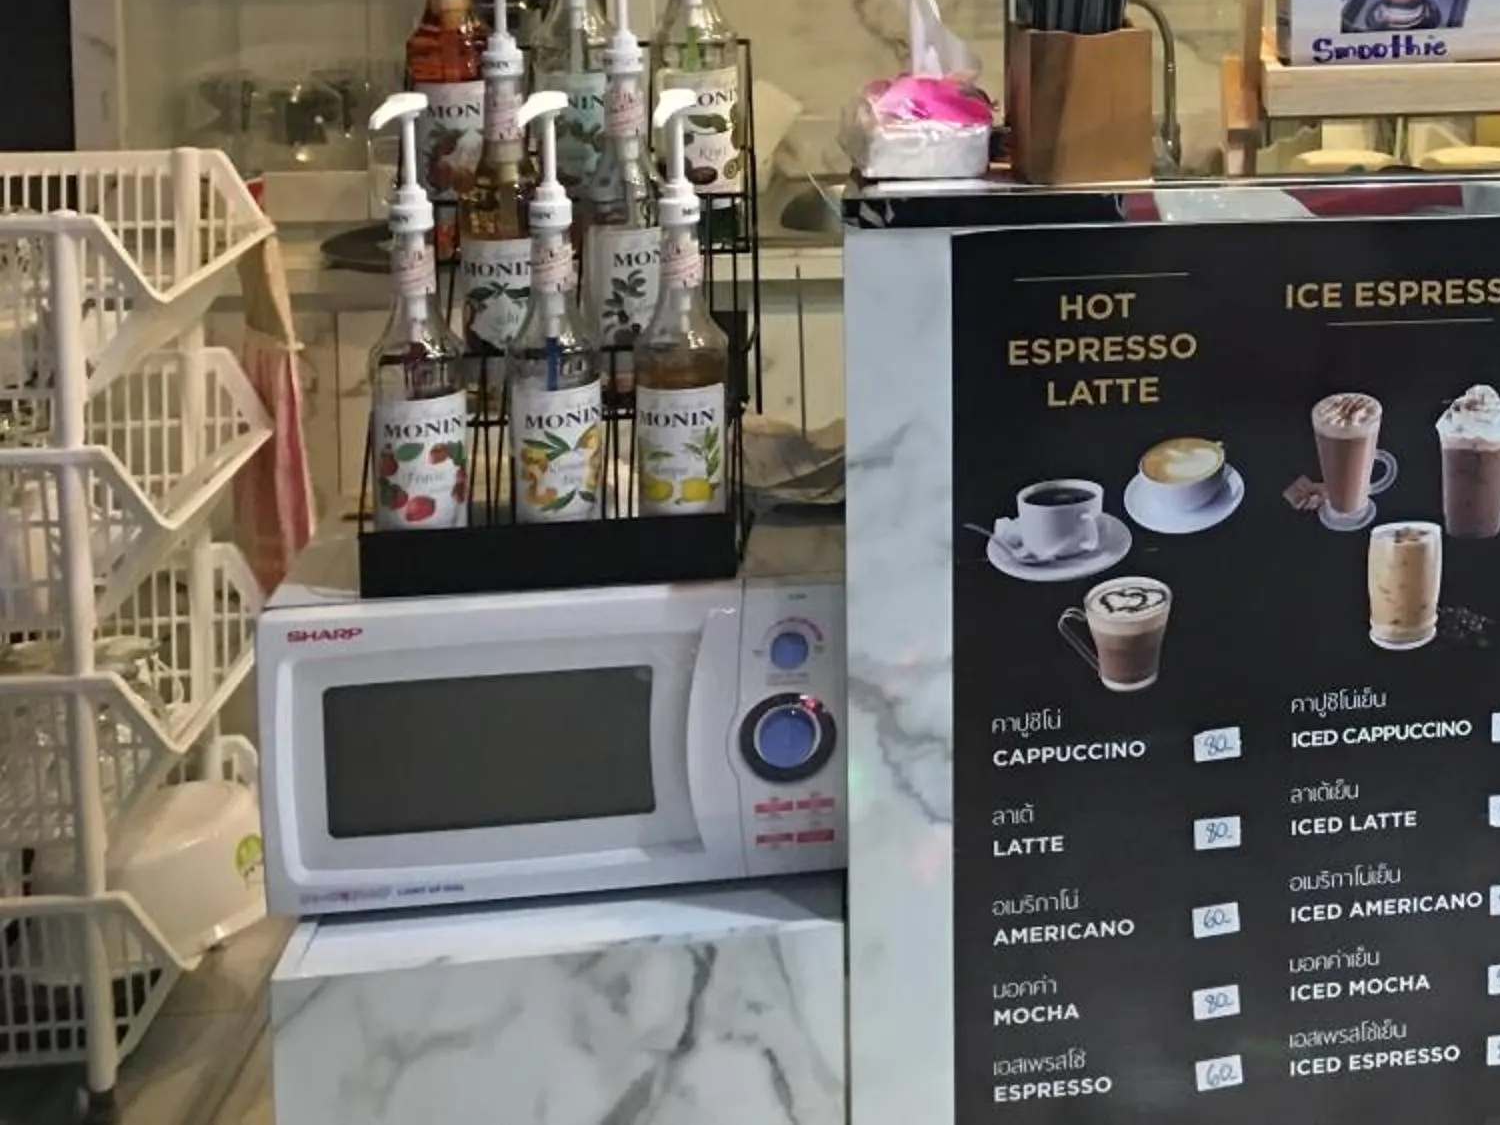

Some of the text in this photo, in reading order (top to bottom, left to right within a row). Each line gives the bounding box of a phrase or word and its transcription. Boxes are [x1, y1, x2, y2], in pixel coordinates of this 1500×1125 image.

[1312, 35, 1448, 63] Smoothie
[1061, 293, 1136, 320] HOT
[1287, 283, 1342, 308] ICE
[1009, 333, 1196, 365] ESPRESSO
[1048, 377, 1159, 406] LATTE
[525, 406, 603, 430] MONIN
[638, 409, 716, 427] MONIN
[287, 627, 363, 643] SHARP
[1292, 720, 1472, 747] ICED CAPPUCCINO
[993, 741, 1145, 766] CAPPUCCINO
[1292, 811, 1416, 835] ICED LATTE
[994, 836, 1064, 856] LATTE
[1291, 892, 1482, 923] ICED AMERICANO
[994, 919, 1134, 946] AMERICANO
[1291, 975, 1430, 1001] ICED MOCHA
[994, 1003, 1079, 1025] MOCHA
[1291, 1045, 1460, 1076] ICED ESPRESSO
[994, 1077, 1112, 1102] ESPRESSO
